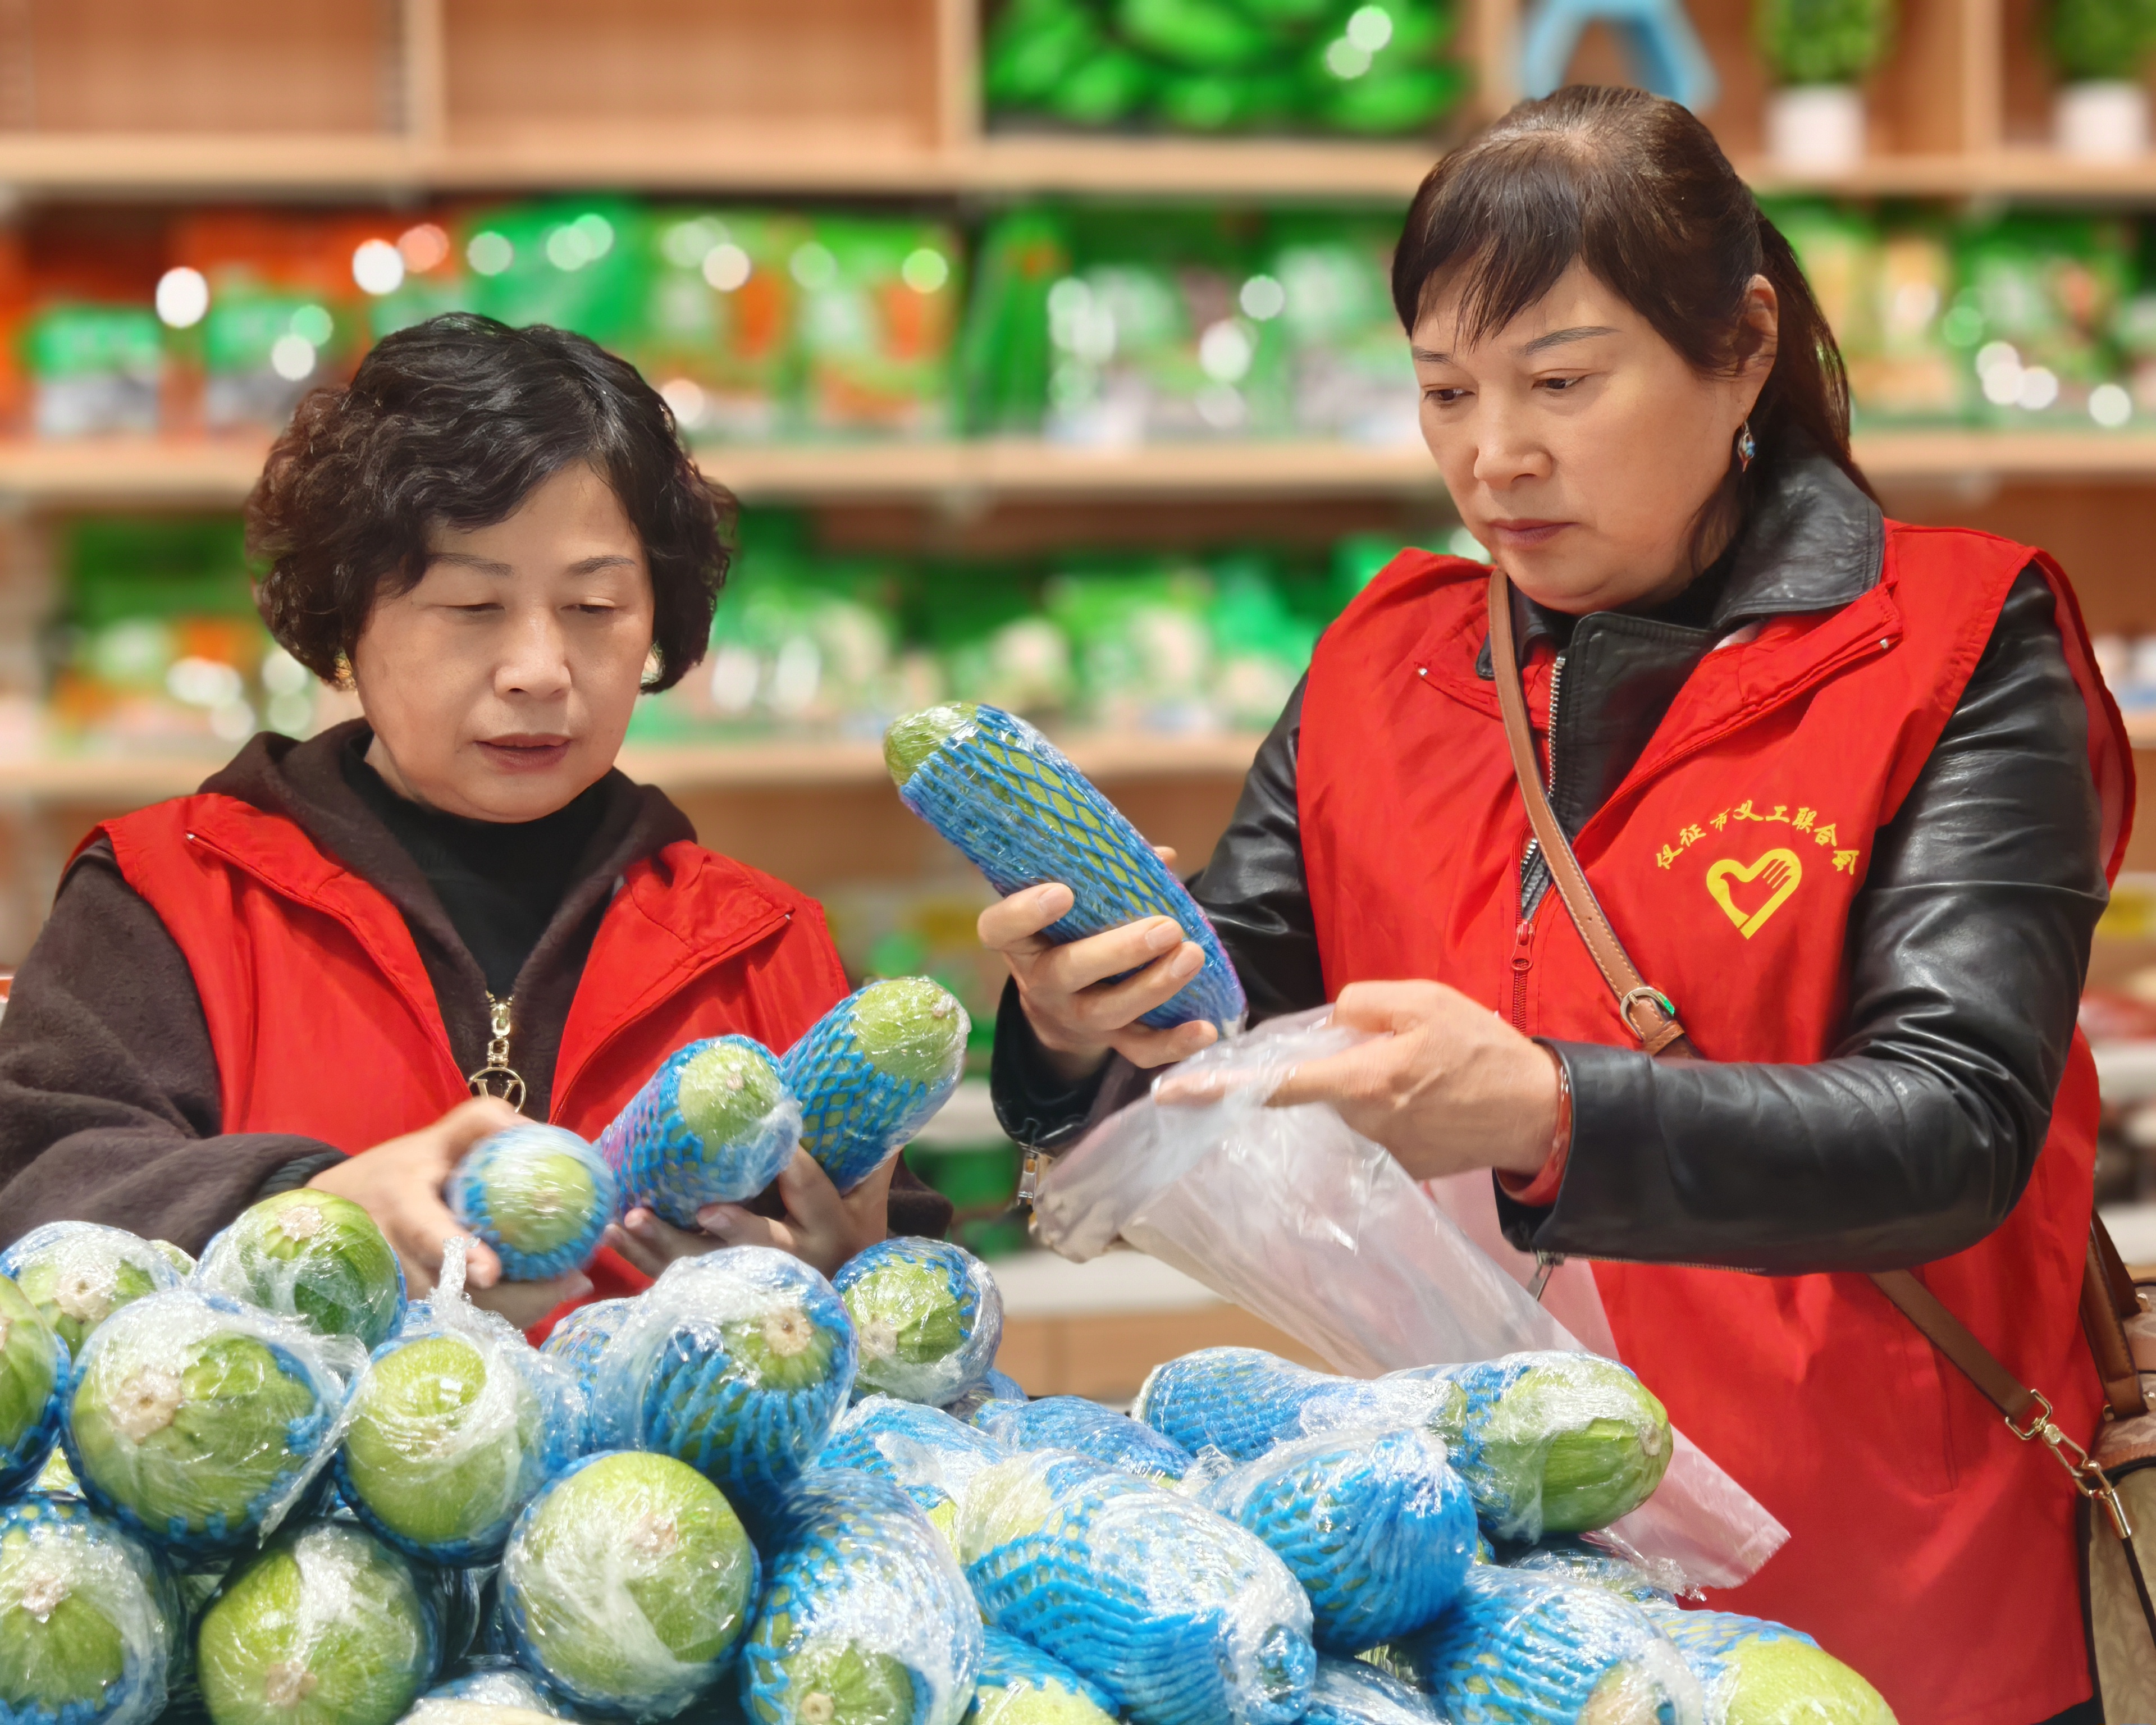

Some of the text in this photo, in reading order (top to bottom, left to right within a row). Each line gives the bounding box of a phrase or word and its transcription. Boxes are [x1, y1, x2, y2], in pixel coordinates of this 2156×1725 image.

[1656, 800, 1859, 875] 仪征市义工联合会
